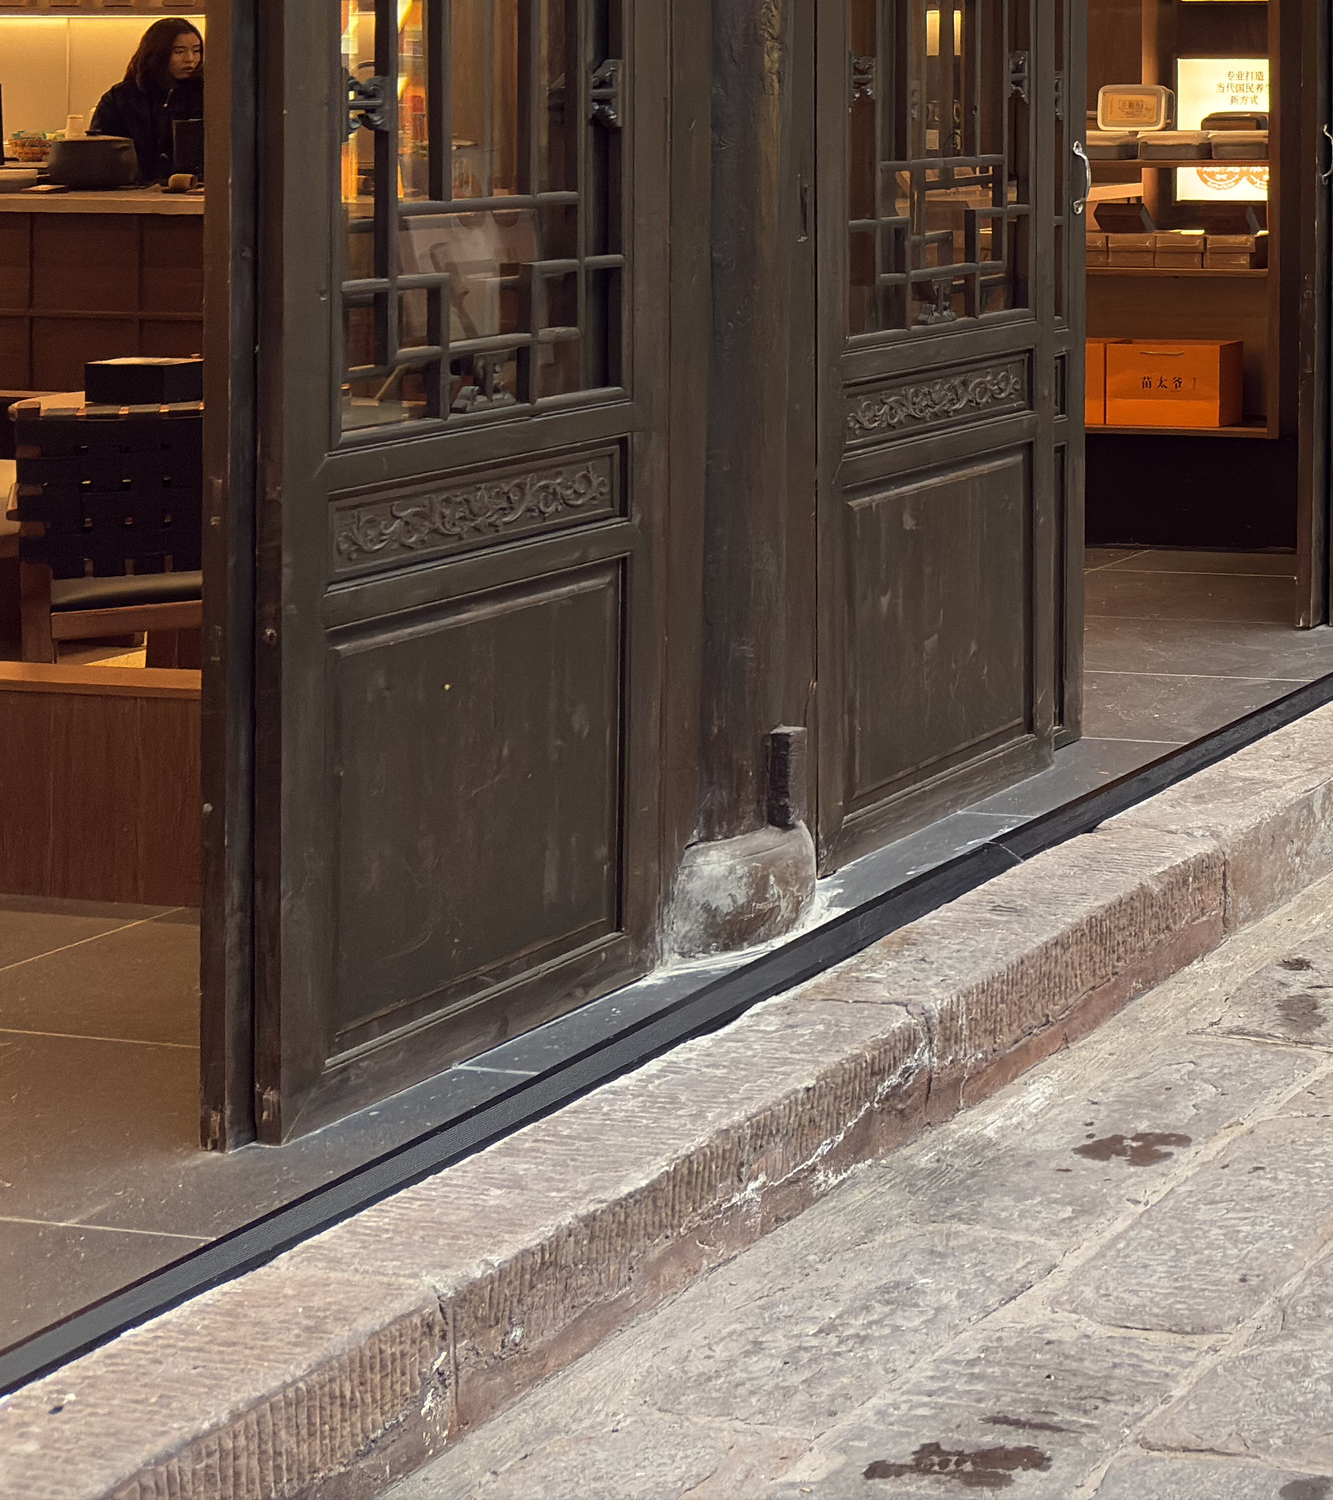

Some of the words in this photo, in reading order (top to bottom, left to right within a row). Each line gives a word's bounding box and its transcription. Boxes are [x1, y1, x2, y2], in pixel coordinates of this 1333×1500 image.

[1226, 70, 1264, 82] 专业打造
[1216, 82, 1269, 94] 当代国民养
[1229, 94, 1259, 106] 新方式
[1141, 376, 1183, 390] 苗太爷
